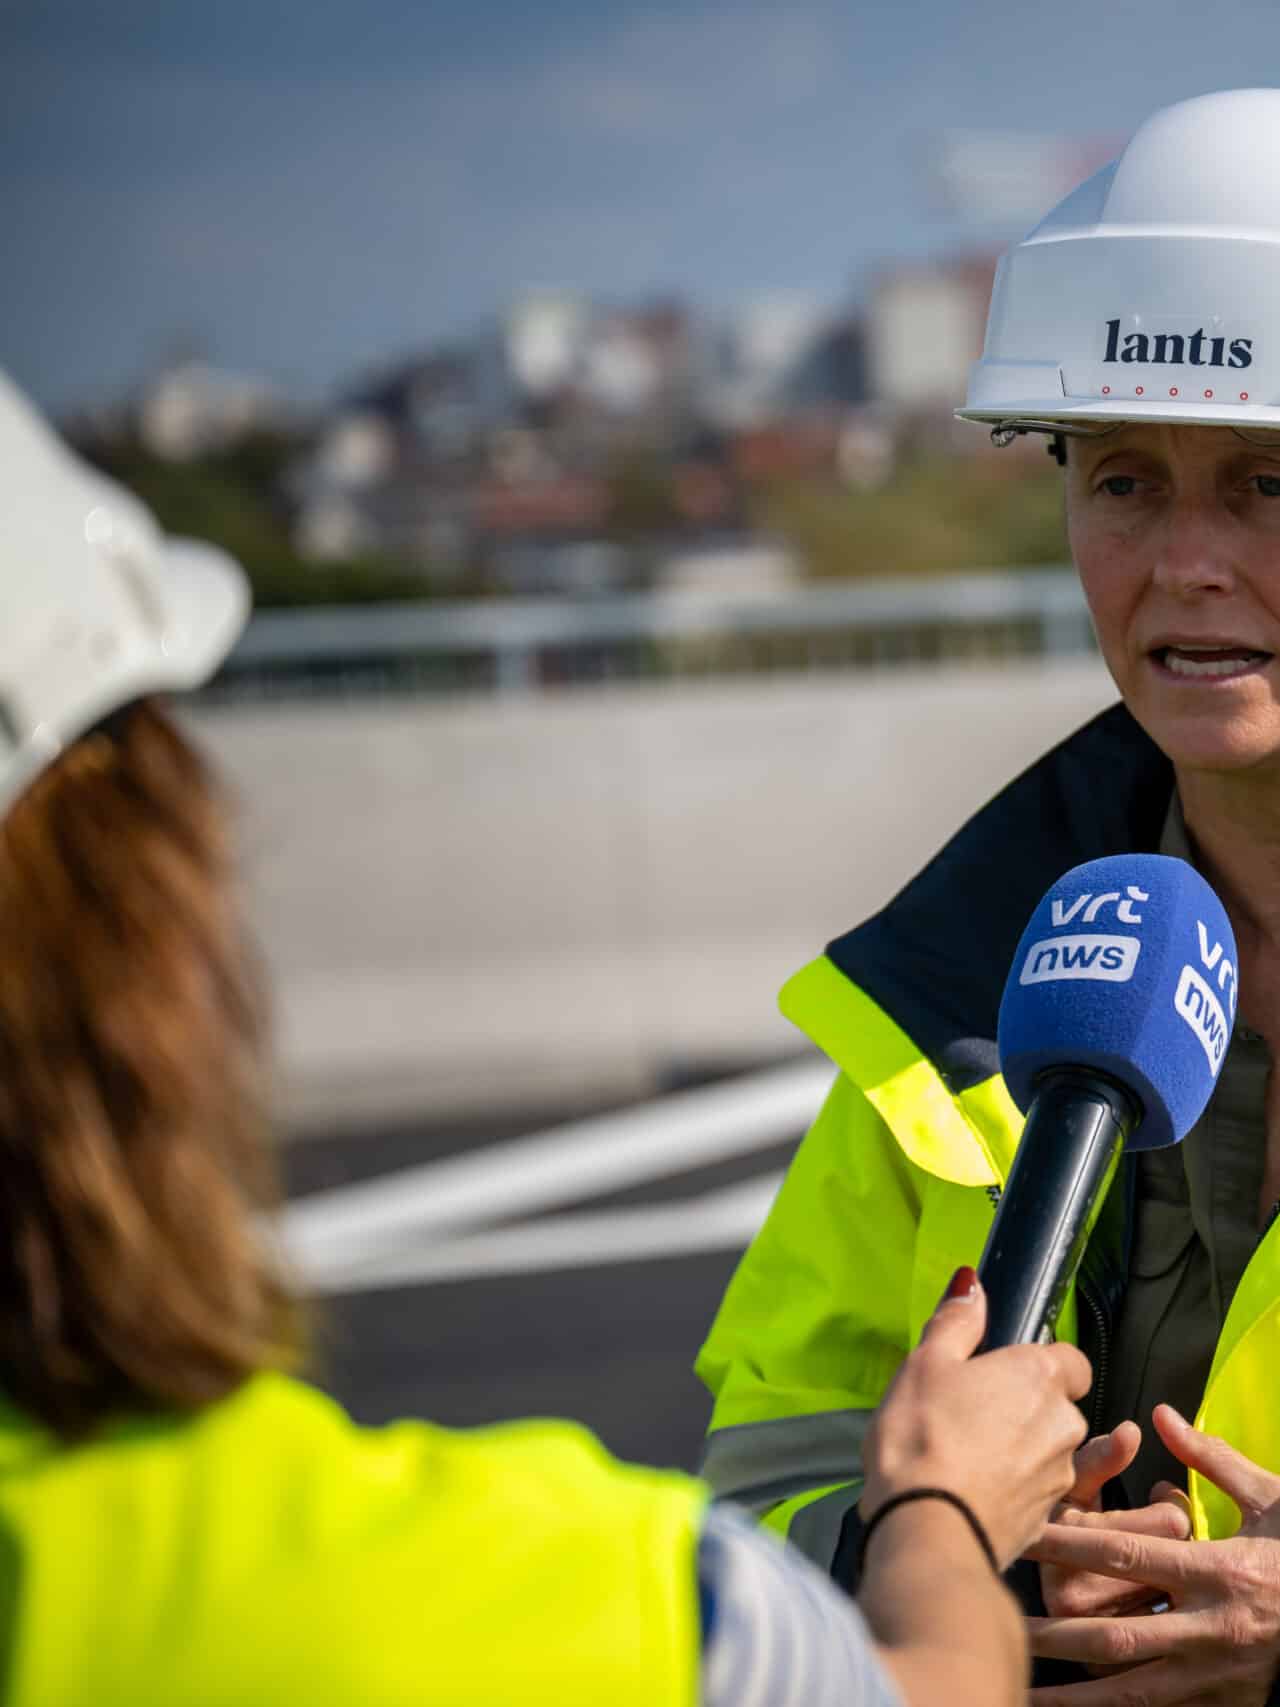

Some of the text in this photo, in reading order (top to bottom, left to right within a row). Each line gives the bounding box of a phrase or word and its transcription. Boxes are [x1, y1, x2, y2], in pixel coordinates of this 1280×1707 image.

[1051, 885, 1149, 927] vrt
[1032, 944, 1125, 974] nws
[1184, 981, 1225, 1059] nws
